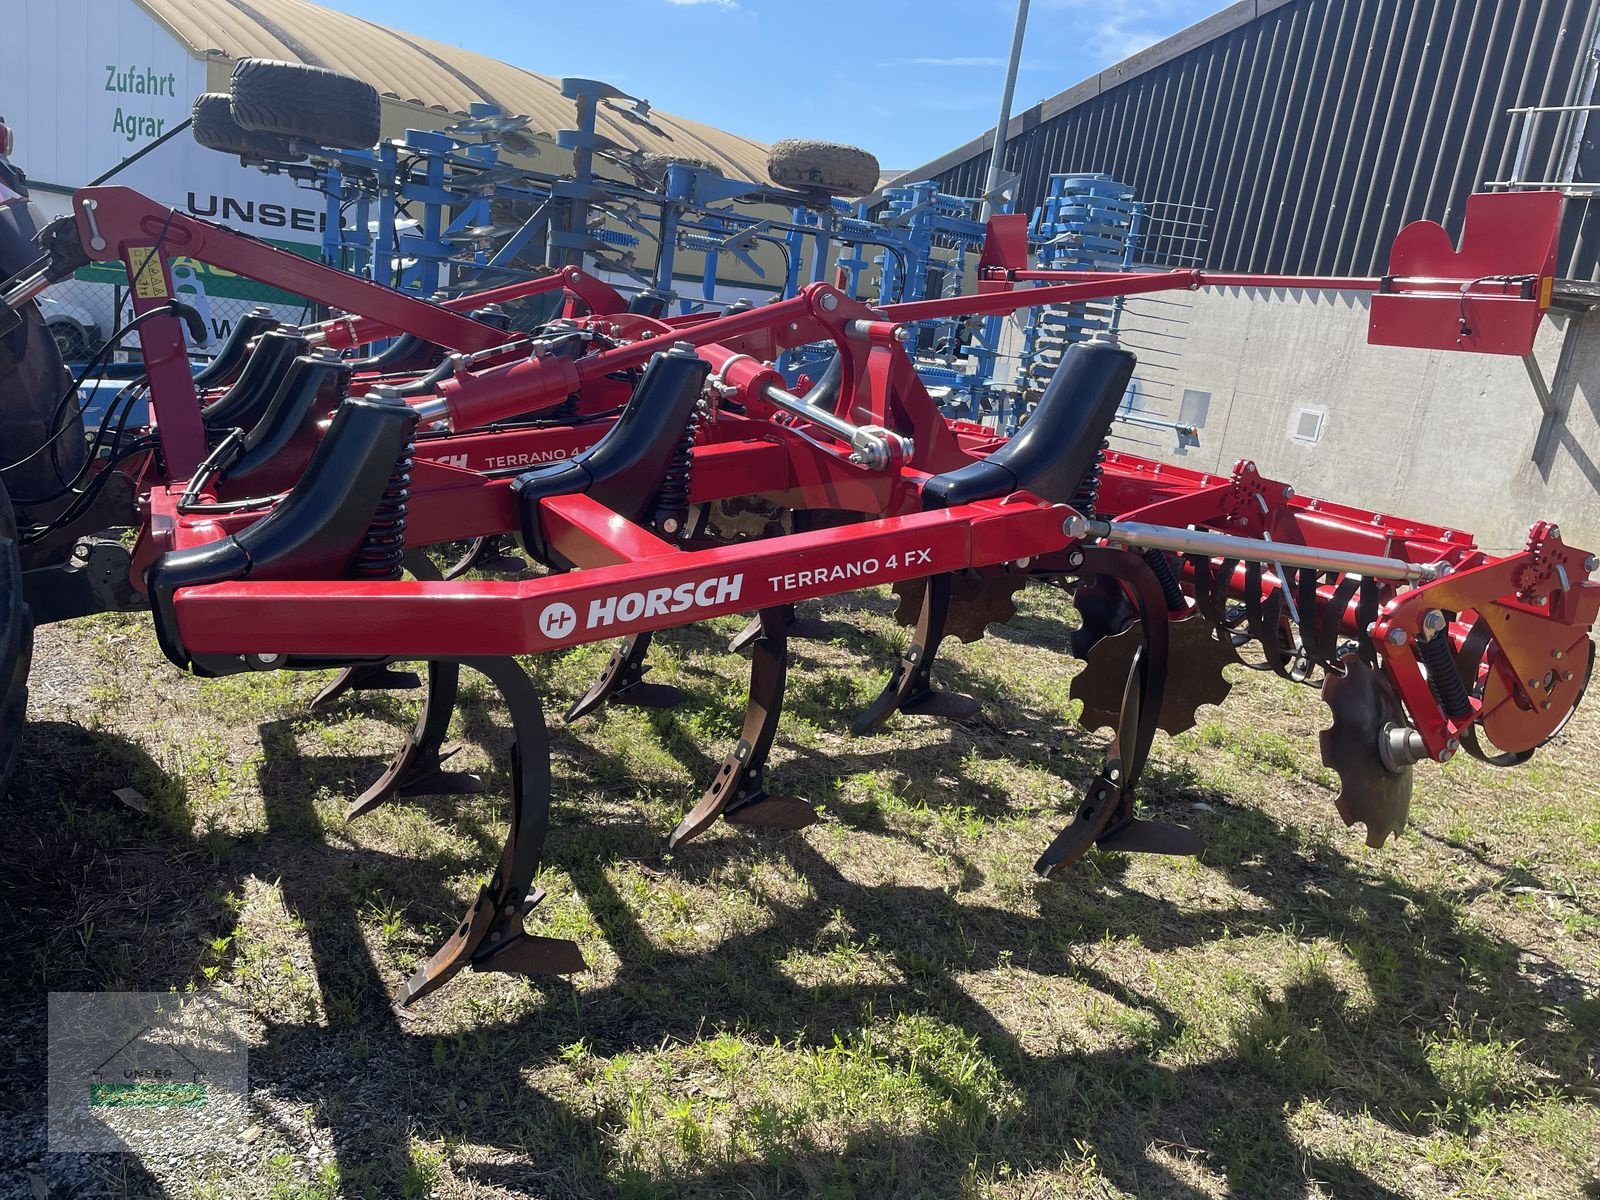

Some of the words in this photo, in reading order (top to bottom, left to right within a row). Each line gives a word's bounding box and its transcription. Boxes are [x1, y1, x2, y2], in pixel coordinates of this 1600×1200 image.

[105, 65, 175, 97] Zufahrt
[113, 107, 165, 142] Agrar
[485, 448, 567, 468] TERRANO
[586, 573, 744, 629] HORSCH
[768, 558, 879, 592] TERRANO
[885, 554, 898, 570] 4
[904, 547, 932, 567] FX
